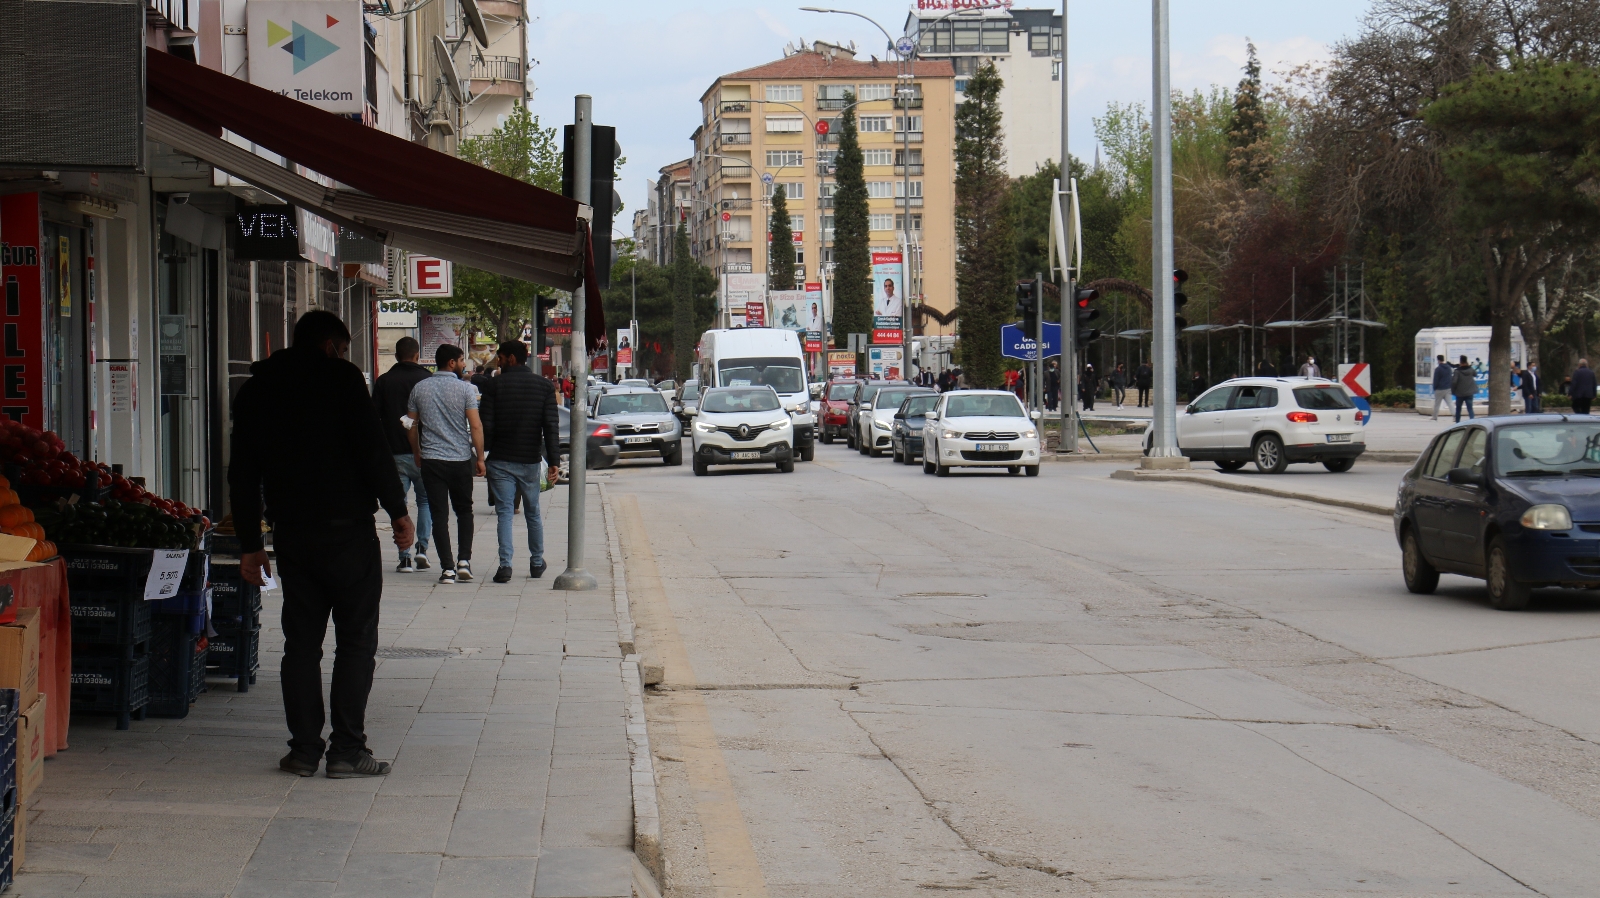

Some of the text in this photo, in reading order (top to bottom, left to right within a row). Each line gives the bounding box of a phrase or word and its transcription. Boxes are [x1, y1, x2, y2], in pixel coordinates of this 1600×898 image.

[294, 88, 353, 101] Telekom
[416, 260, 442, 290] E
[1014, 341, 1050, 350] CADDSİ
